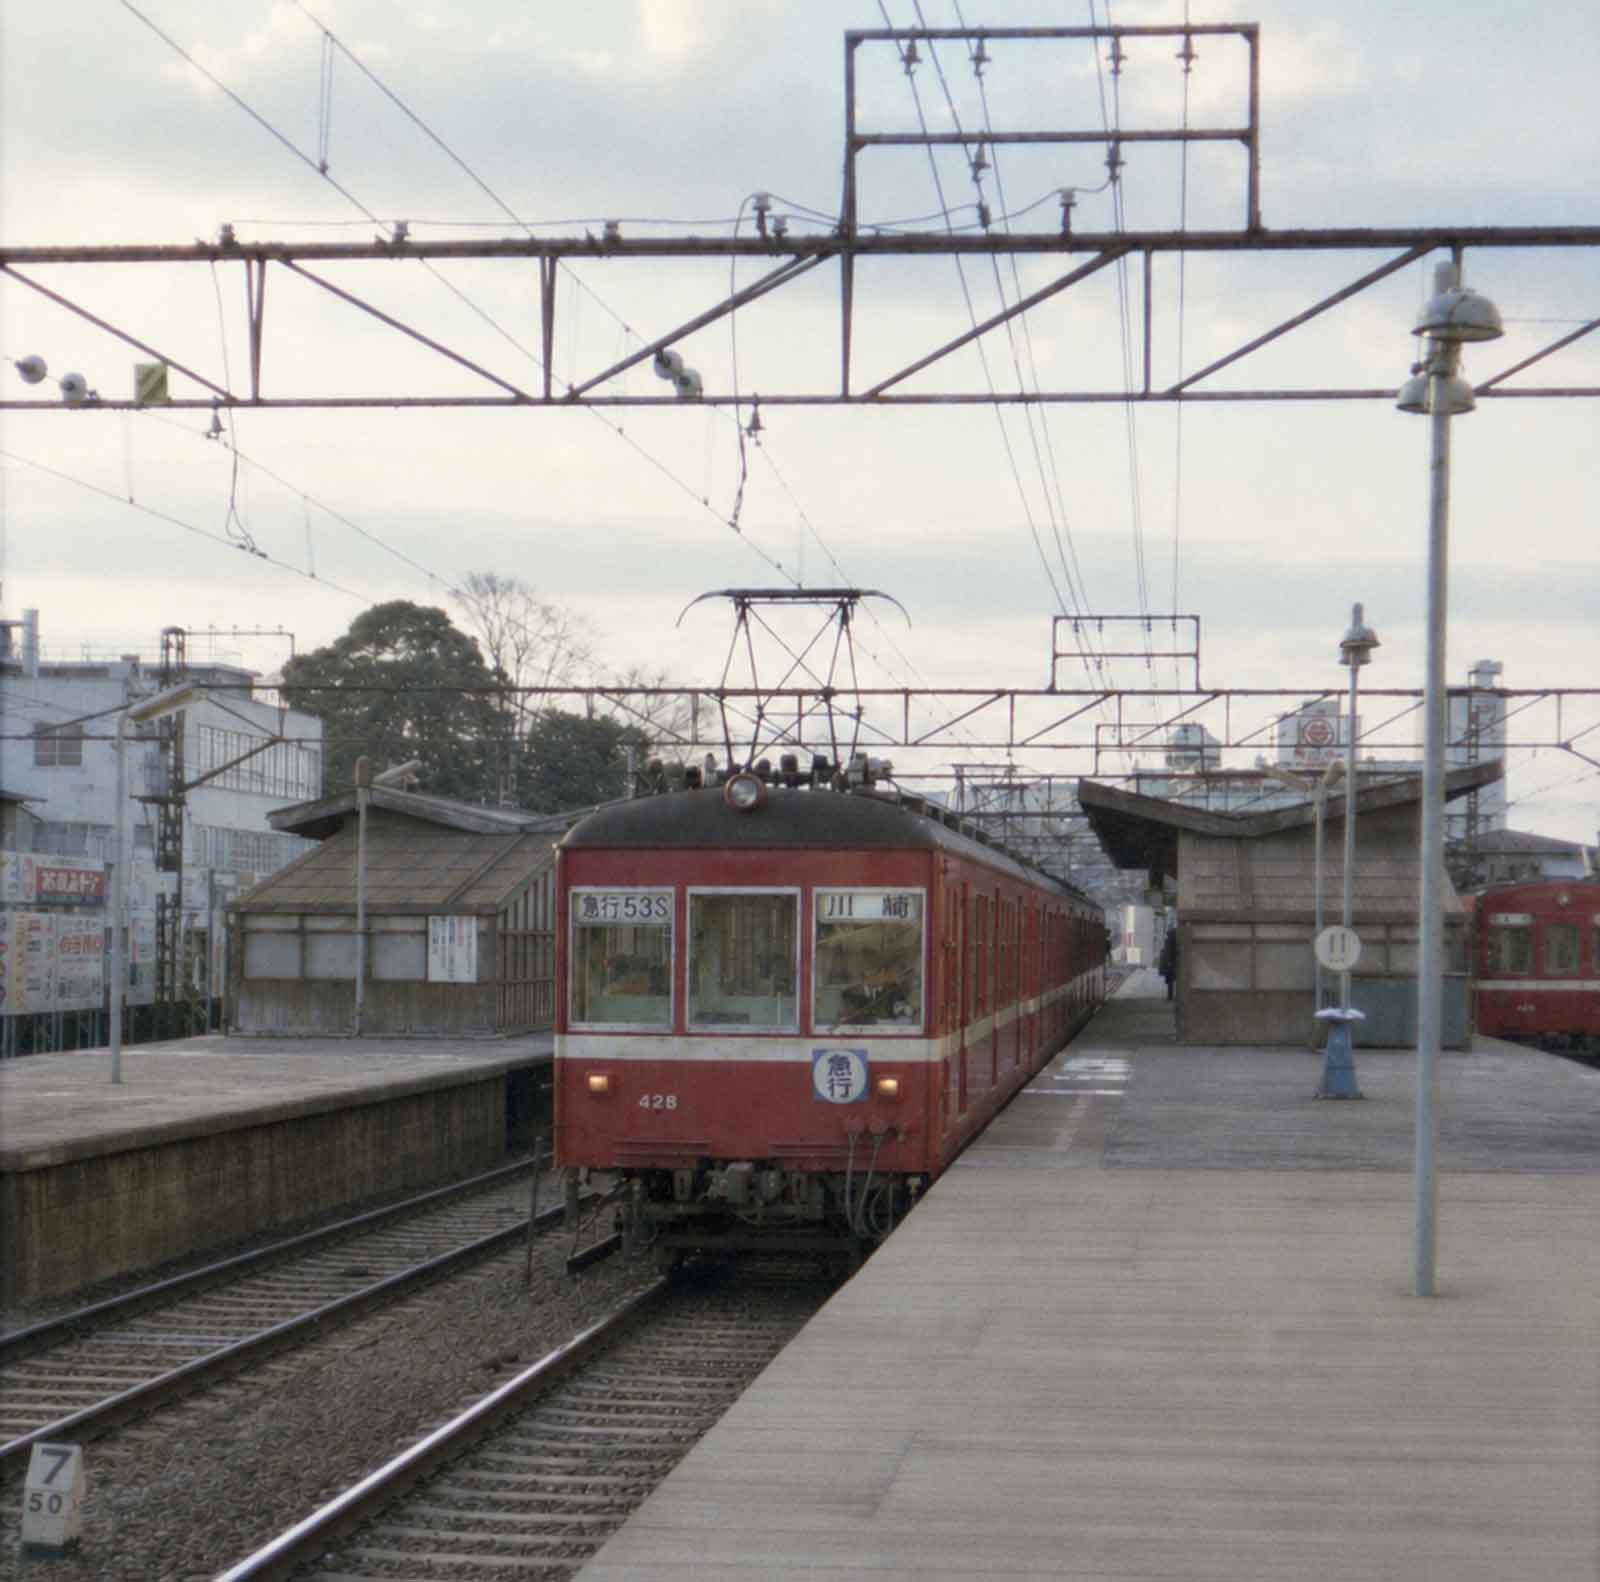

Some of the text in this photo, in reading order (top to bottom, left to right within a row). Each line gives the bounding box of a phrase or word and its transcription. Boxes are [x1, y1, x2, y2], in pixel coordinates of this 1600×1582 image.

[827, 1053, 853, 1098] 急行
[639, 1094, 678, 1111] 428
[41, 1448, 72, 1485] 7
[28, 1492, 62, 1514] 50
